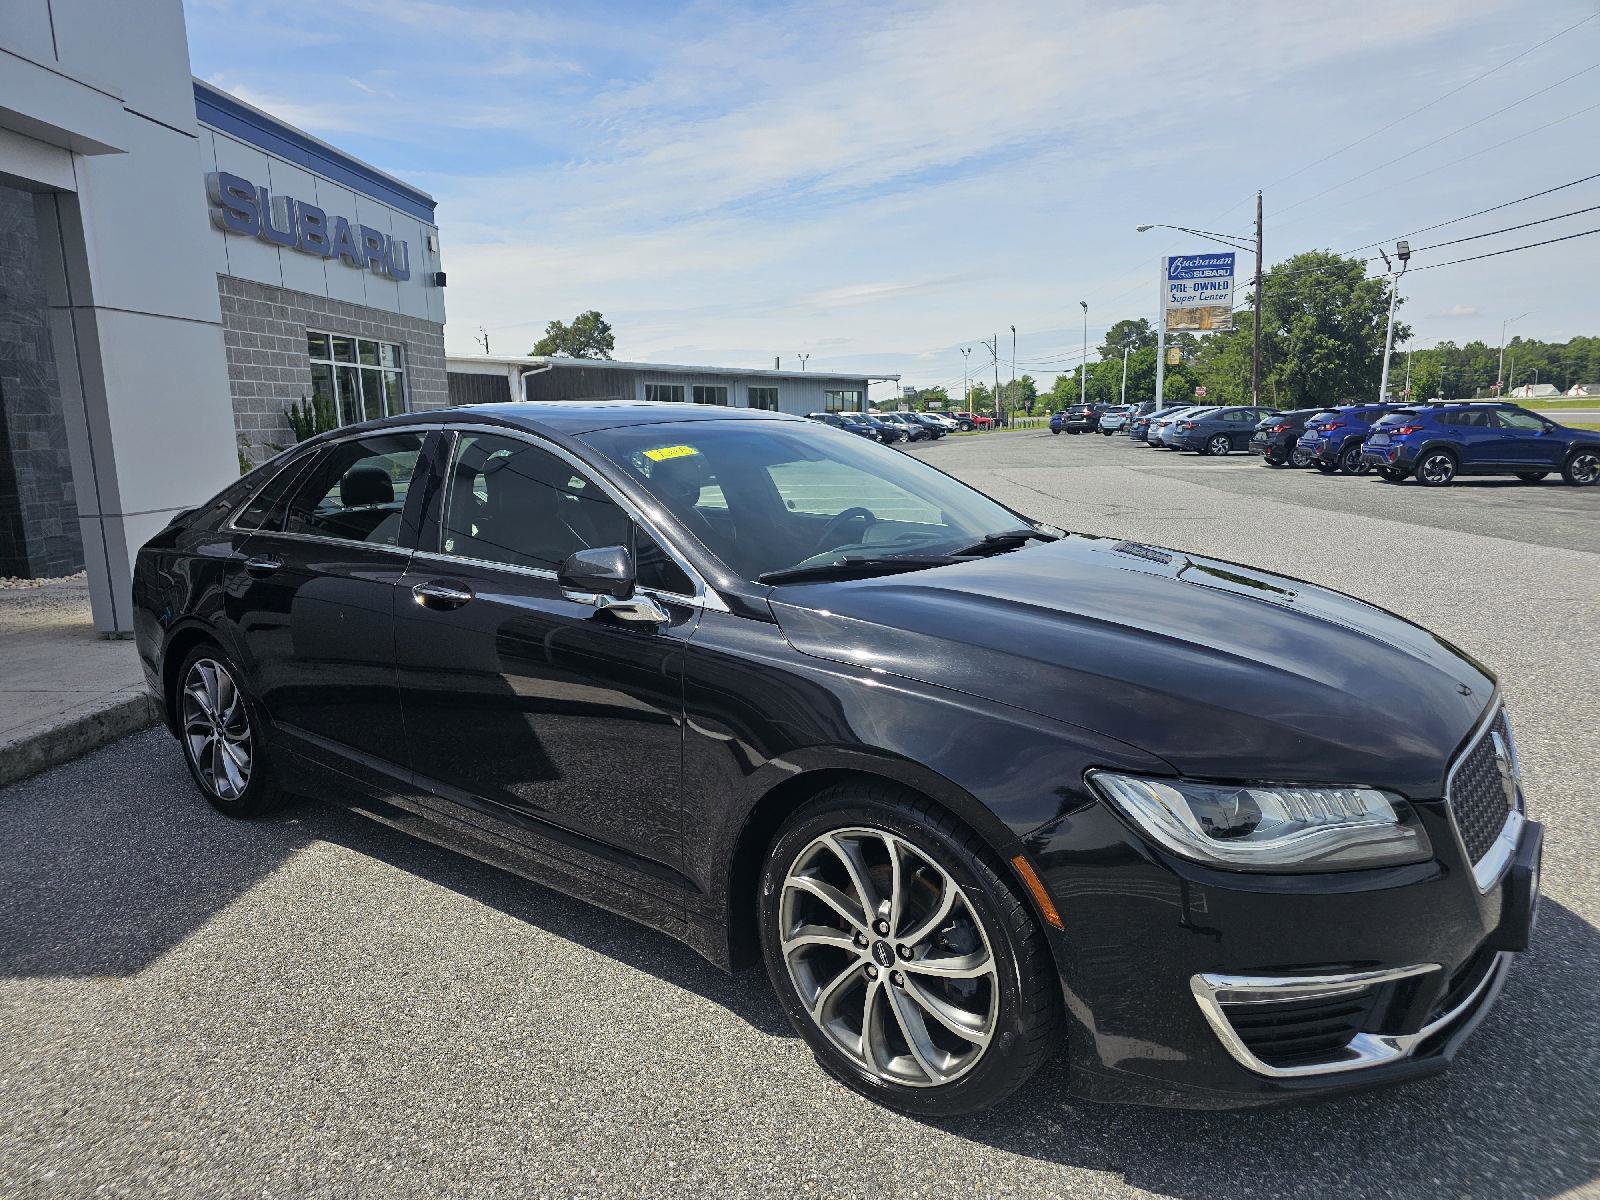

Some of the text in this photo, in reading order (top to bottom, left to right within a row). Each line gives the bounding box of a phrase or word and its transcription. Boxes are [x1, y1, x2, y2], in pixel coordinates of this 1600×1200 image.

[205, 172, 410, 282] SUBARU
[1170, 256, 1232, 276] Buchanan
[1193, 269, 1230, 278] SUBARU
[1170, 281, 1229, 293] PRE-OWNED
[1171, 292, 1229, 305] Super Center
